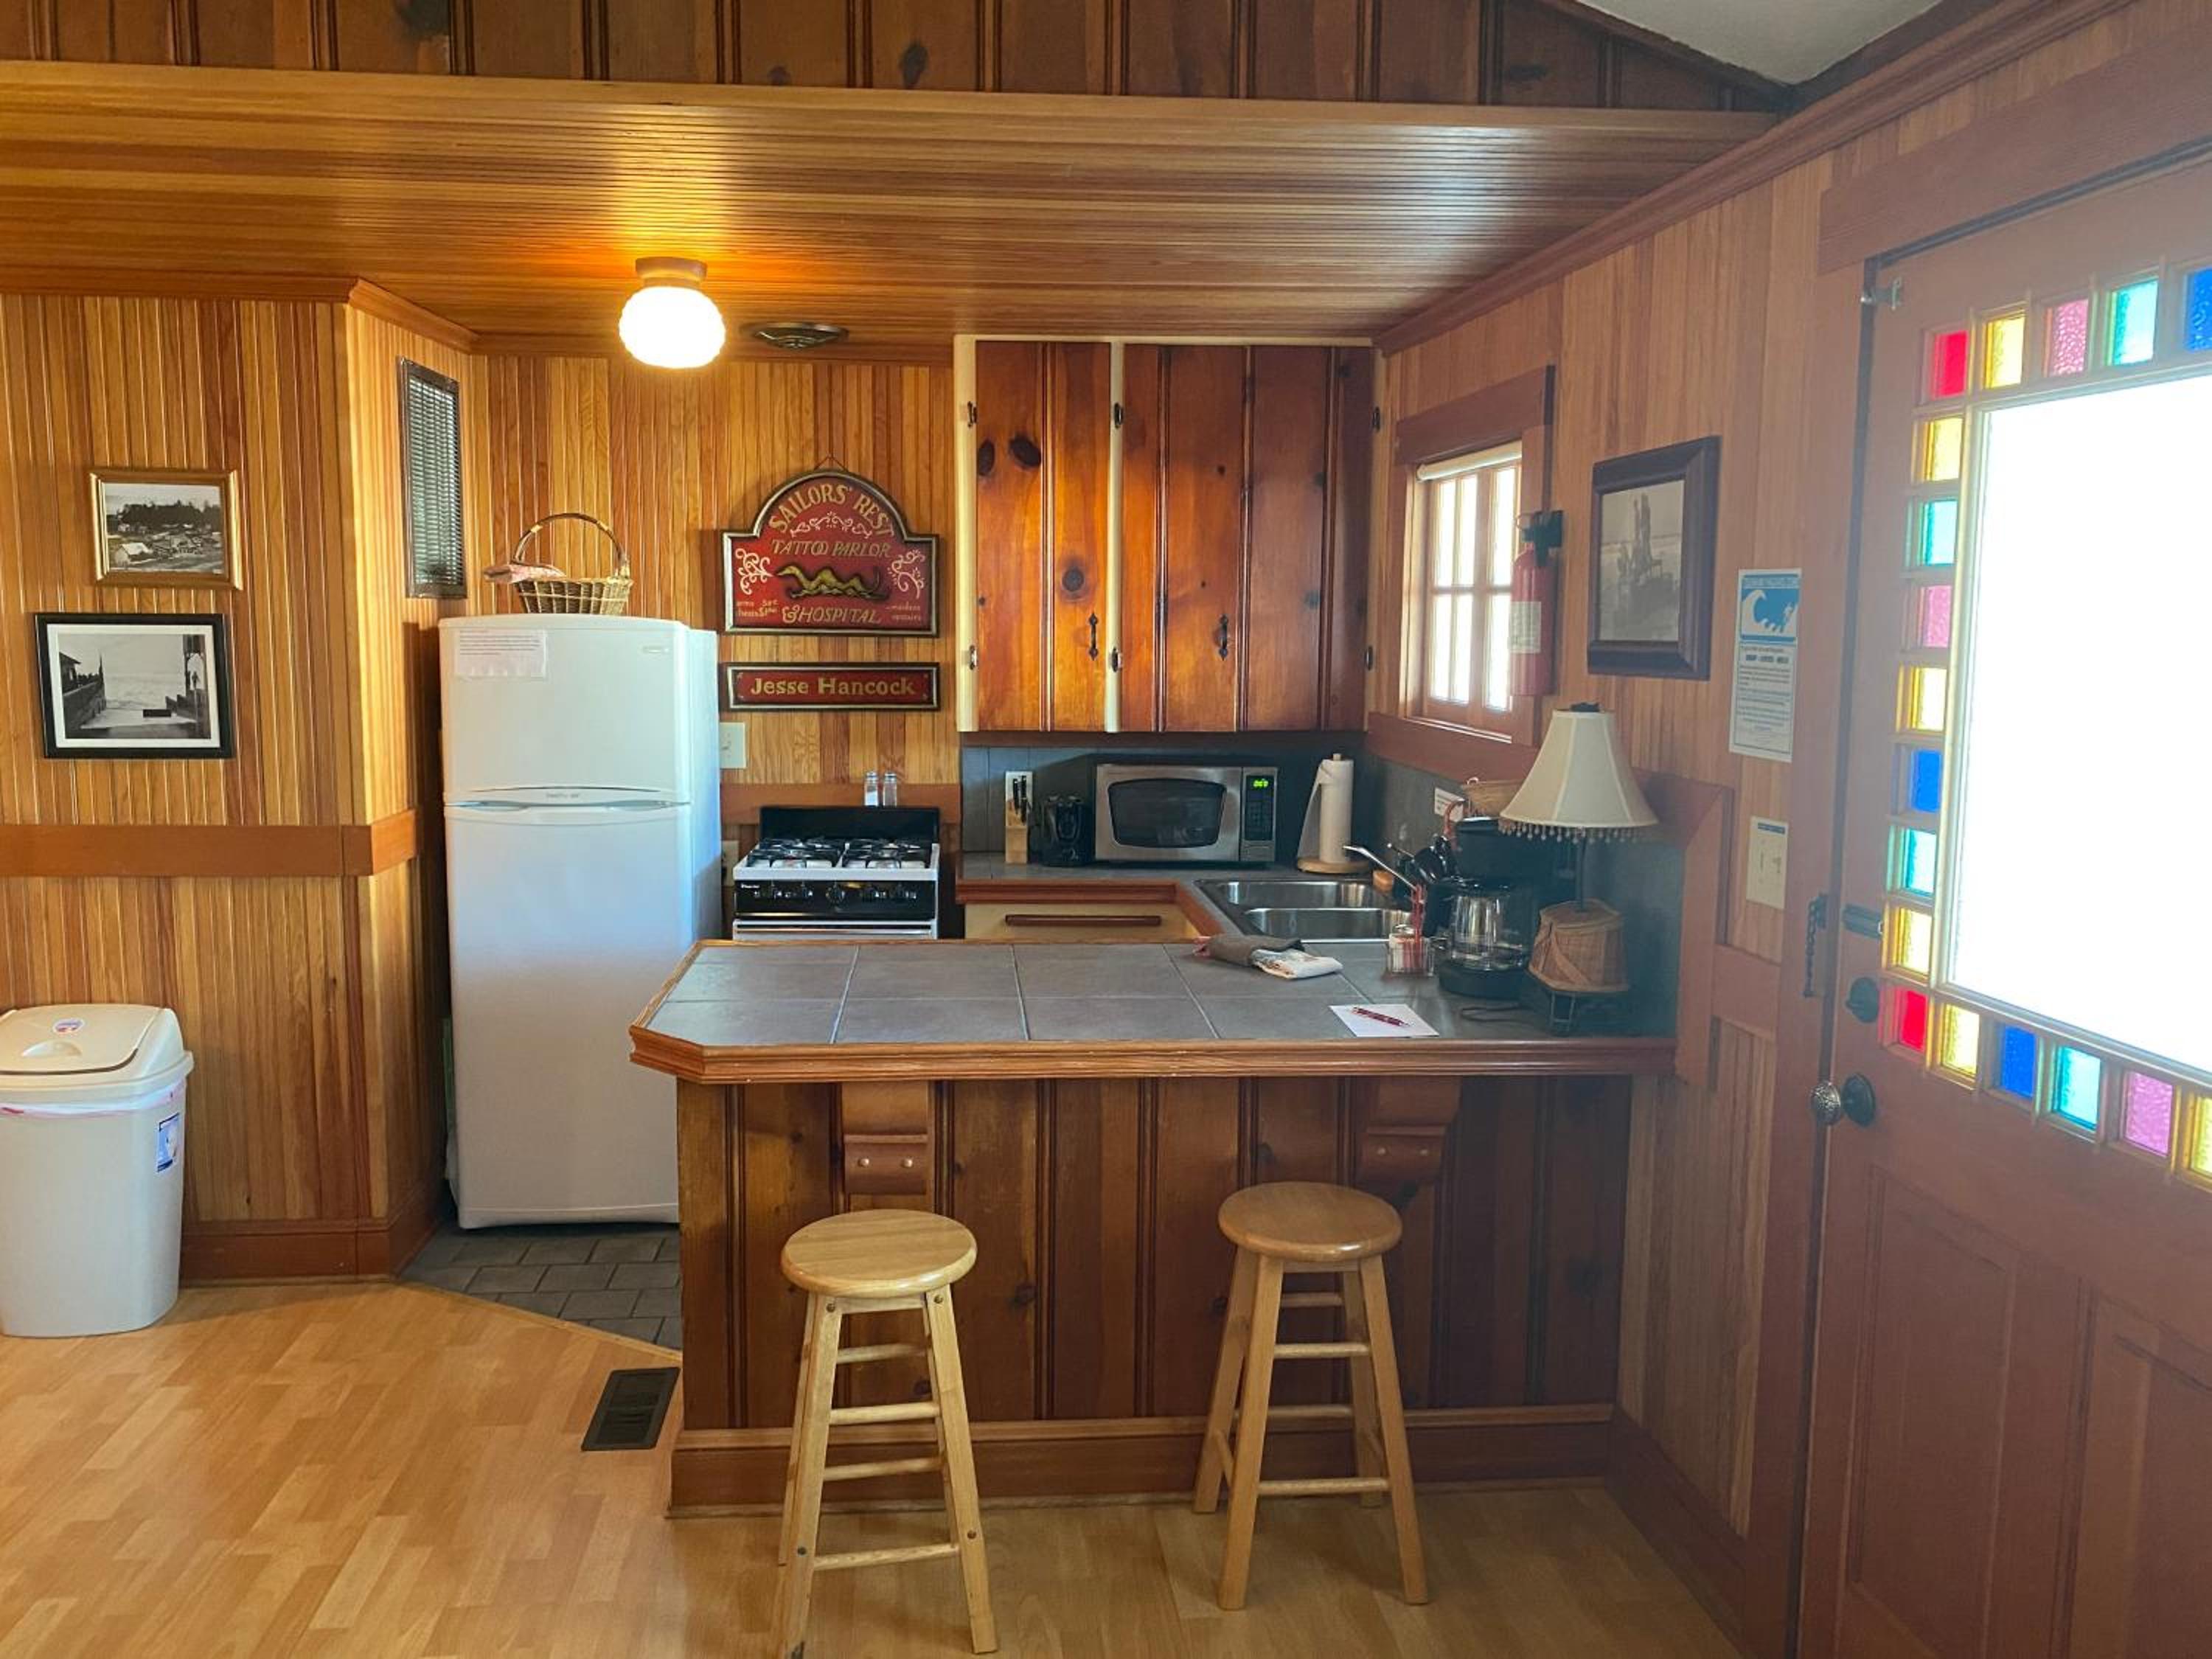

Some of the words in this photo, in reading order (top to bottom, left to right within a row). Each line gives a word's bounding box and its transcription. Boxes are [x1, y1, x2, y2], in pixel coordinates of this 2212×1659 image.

[853, 493, 894, 537] REST
[771, 540, 830, 555] TATTOO
[831, 540, 891, 558] PARLOR
[750, 678, 809, 695] Jesse
[817, 676, 916, 696] Hancock
